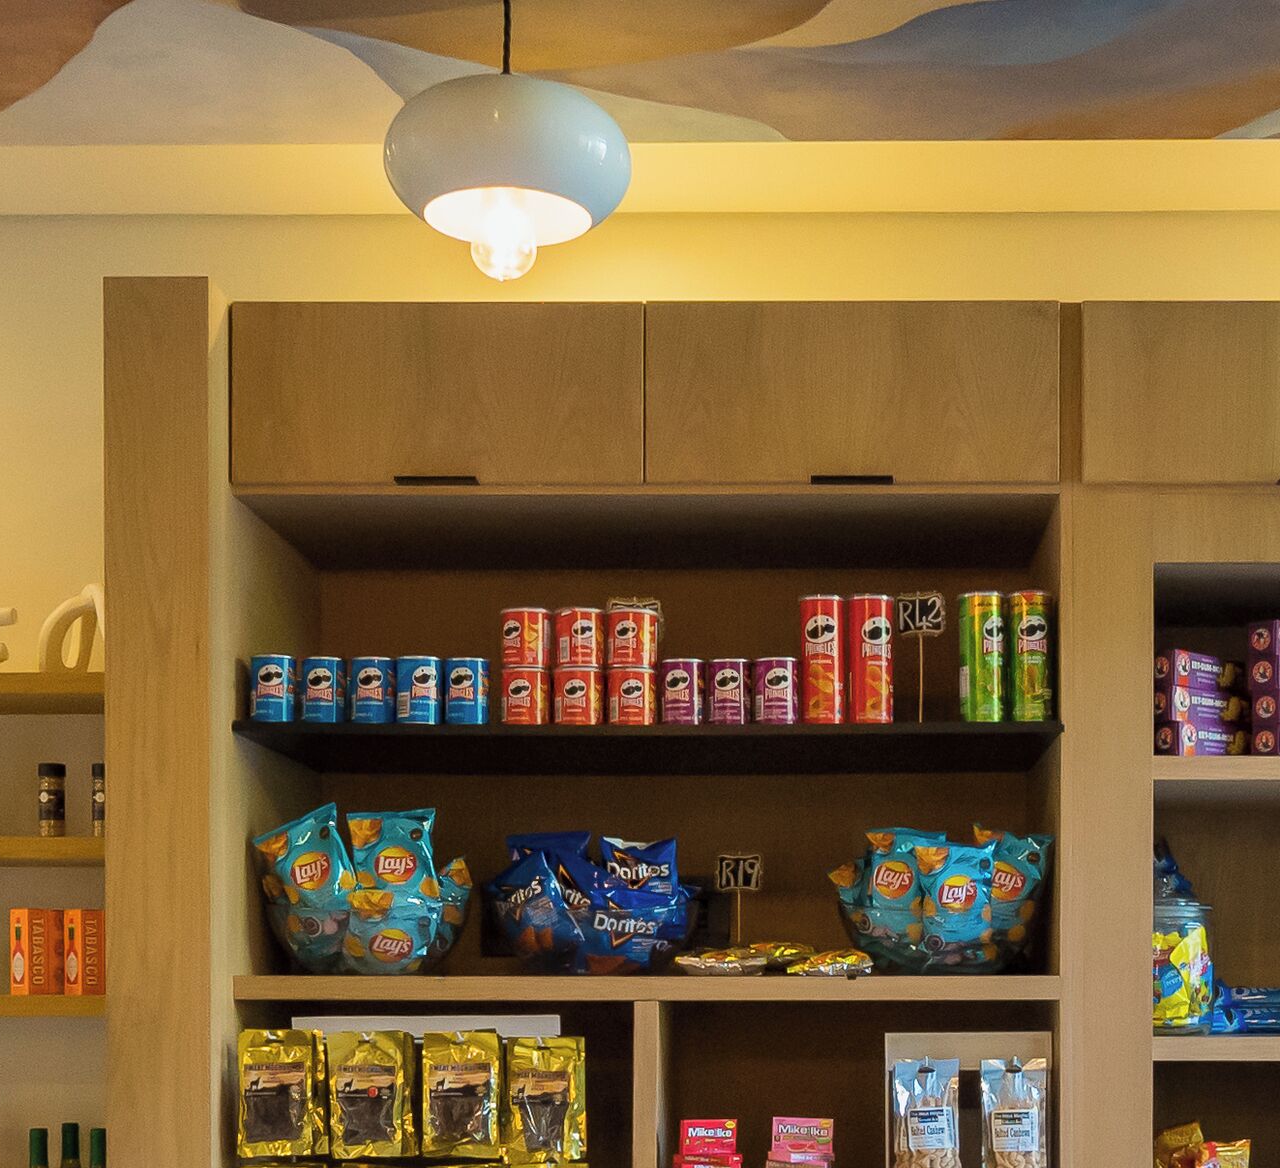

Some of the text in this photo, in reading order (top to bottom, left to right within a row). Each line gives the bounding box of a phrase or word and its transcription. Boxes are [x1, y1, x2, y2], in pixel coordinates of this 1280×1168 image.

[805, 641, 836, 657] PRINGLES
[293, 855, 330, 885] Lay's
[379, 855, 414, 876] Lay's
[607, 861, 670, 880] Doritos
[722, 860, 760, 888] R19
[876, 865, 912, 887] Lay's
[942, 879, 978, 903] Lay's
[594, 913, 656, 935] Doritos
[32, 919, 45, 985] TABASCO
[85, 919, 98, 985] TABASCO
[373, 932, 411, 954] Lay's
[688, 1127, 714, 1138] Mike
[779, 1124, 828, 1136] Mike Ike
